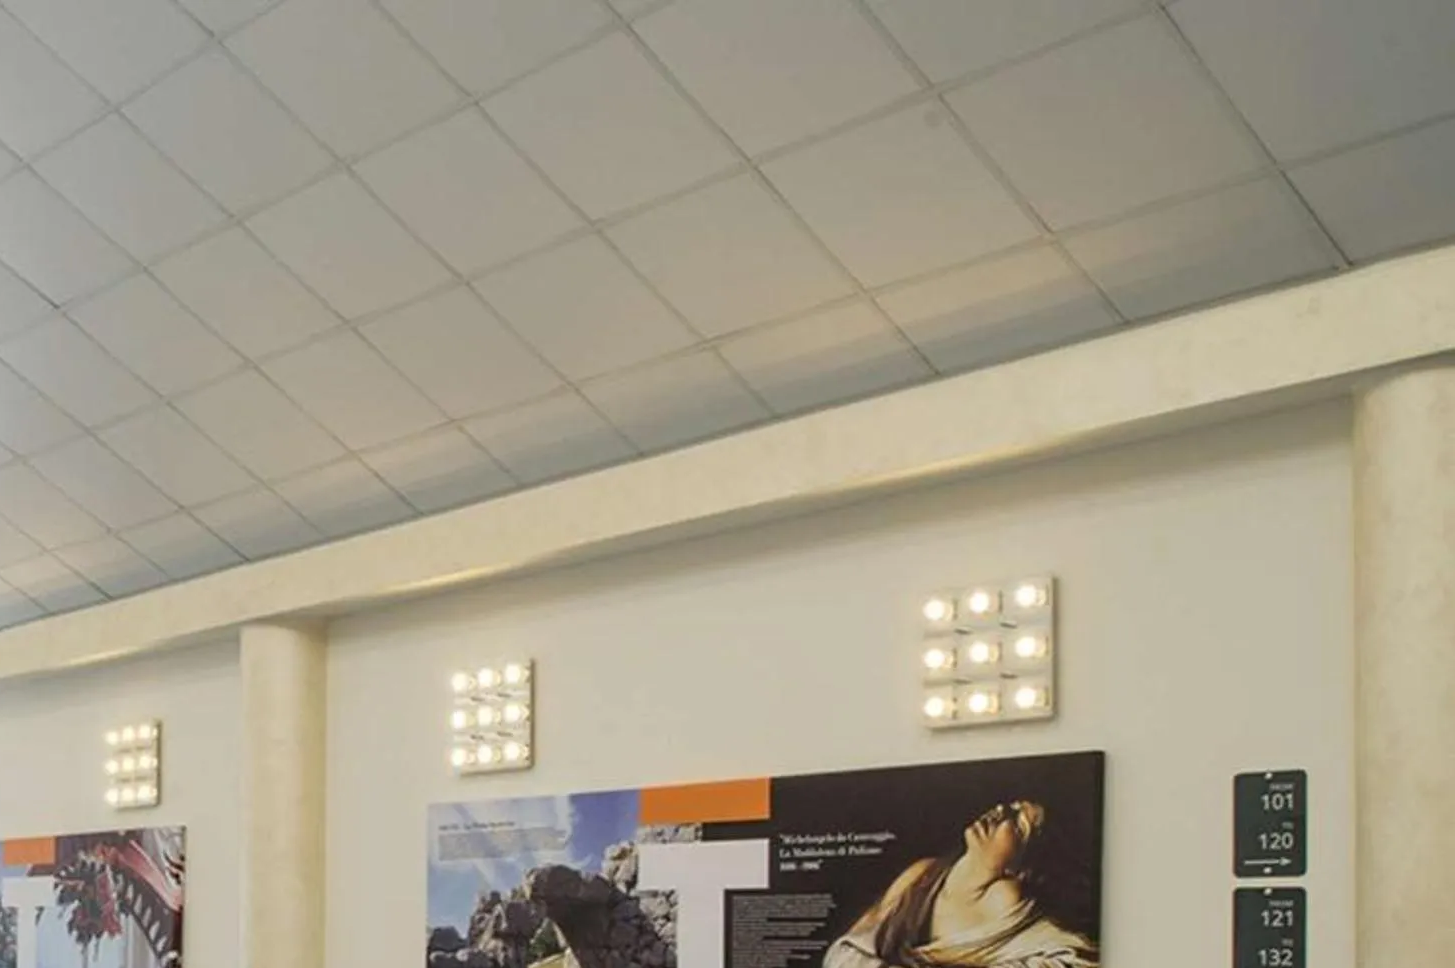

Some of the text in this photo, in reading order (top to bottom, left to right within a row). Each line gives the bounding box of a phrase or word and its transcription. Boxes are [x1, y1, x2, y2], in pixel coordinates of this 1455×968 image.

[1260, 792, 1294, 811] 101
[1258, 832, 1294, 850] 120
[1260, 909, 1294, 927] 121
[1258, 949, 1294, 967] 132
